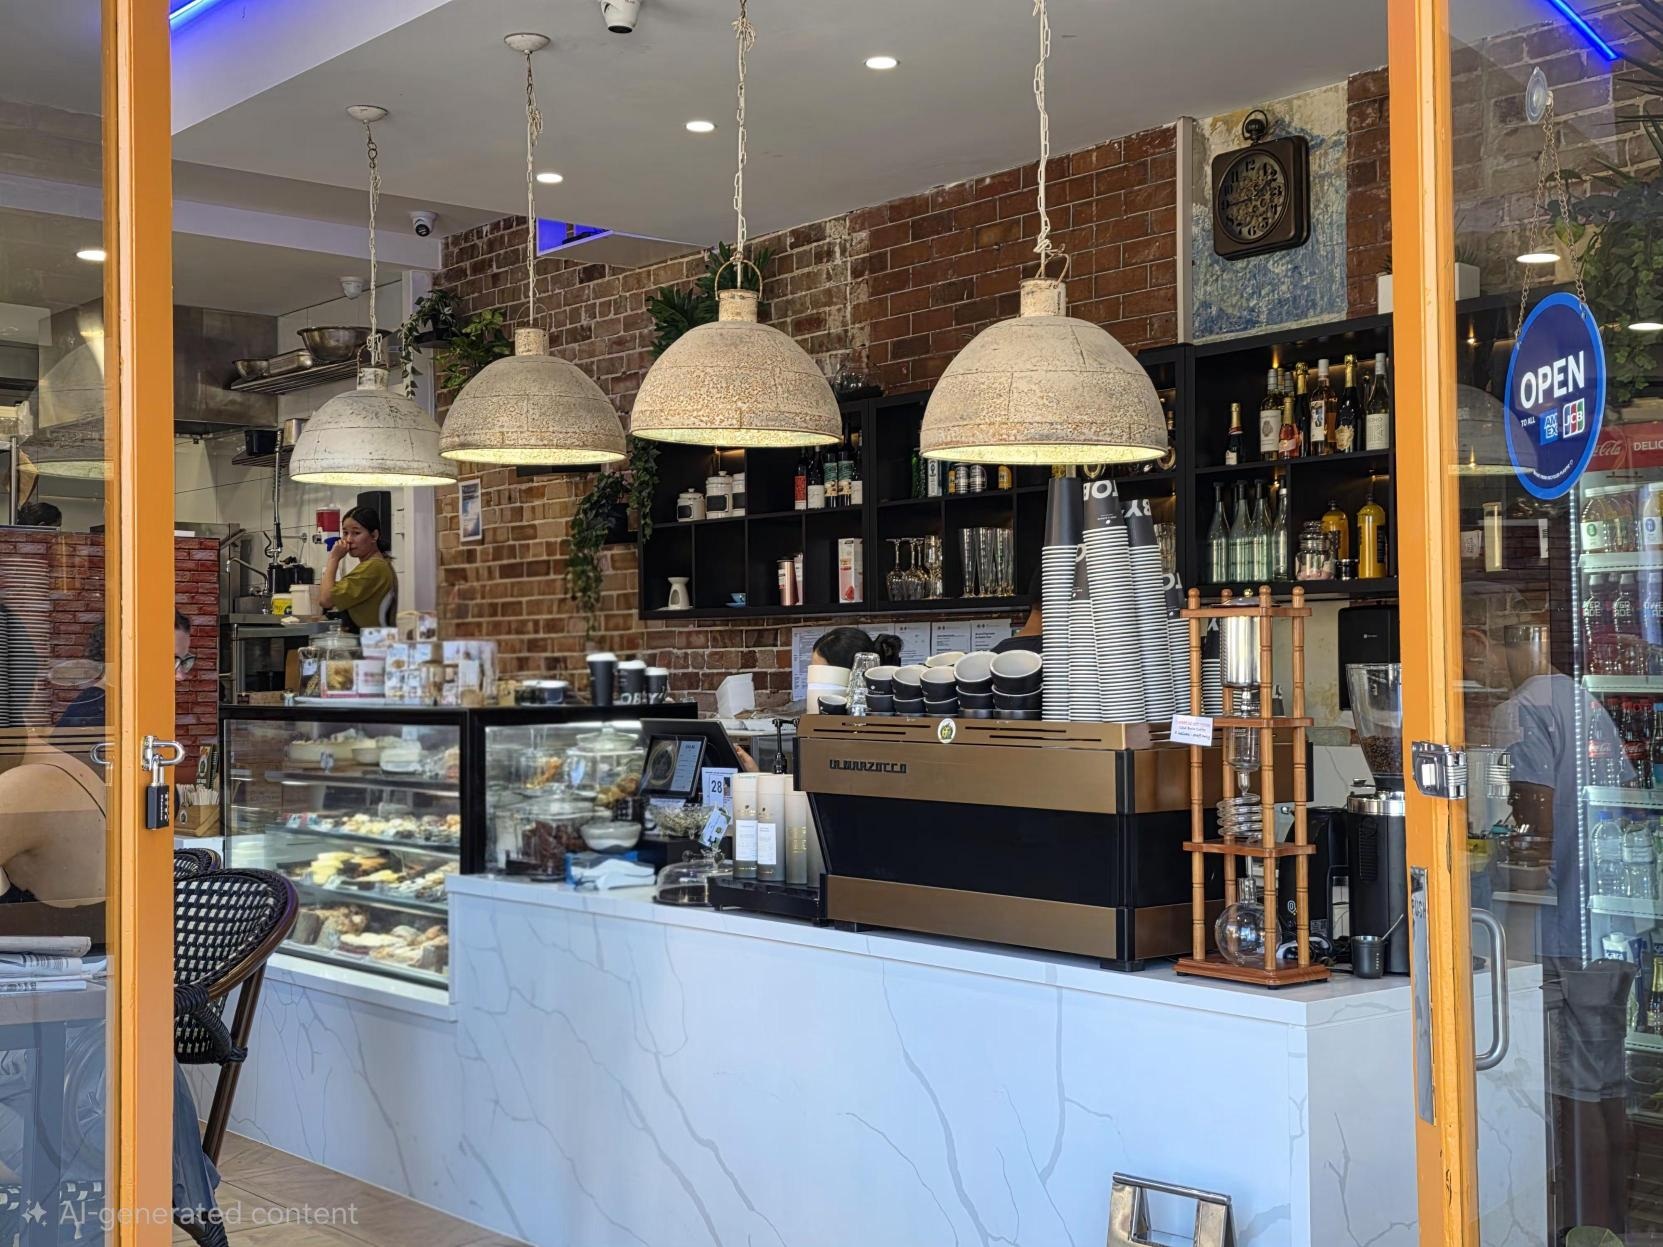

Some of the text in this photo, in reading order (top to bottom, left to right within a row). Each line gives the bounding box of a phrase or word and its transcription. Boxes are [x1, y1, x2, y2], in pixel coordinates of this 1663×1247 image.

[1245, 159, 1256, 172] 12
[1247, 225, 1257, 237] 6
[1520, 350, 1585, 409] OPEN
[1564, 410, 1583, 427] JCB
[711, 780, 723, 794] 28
